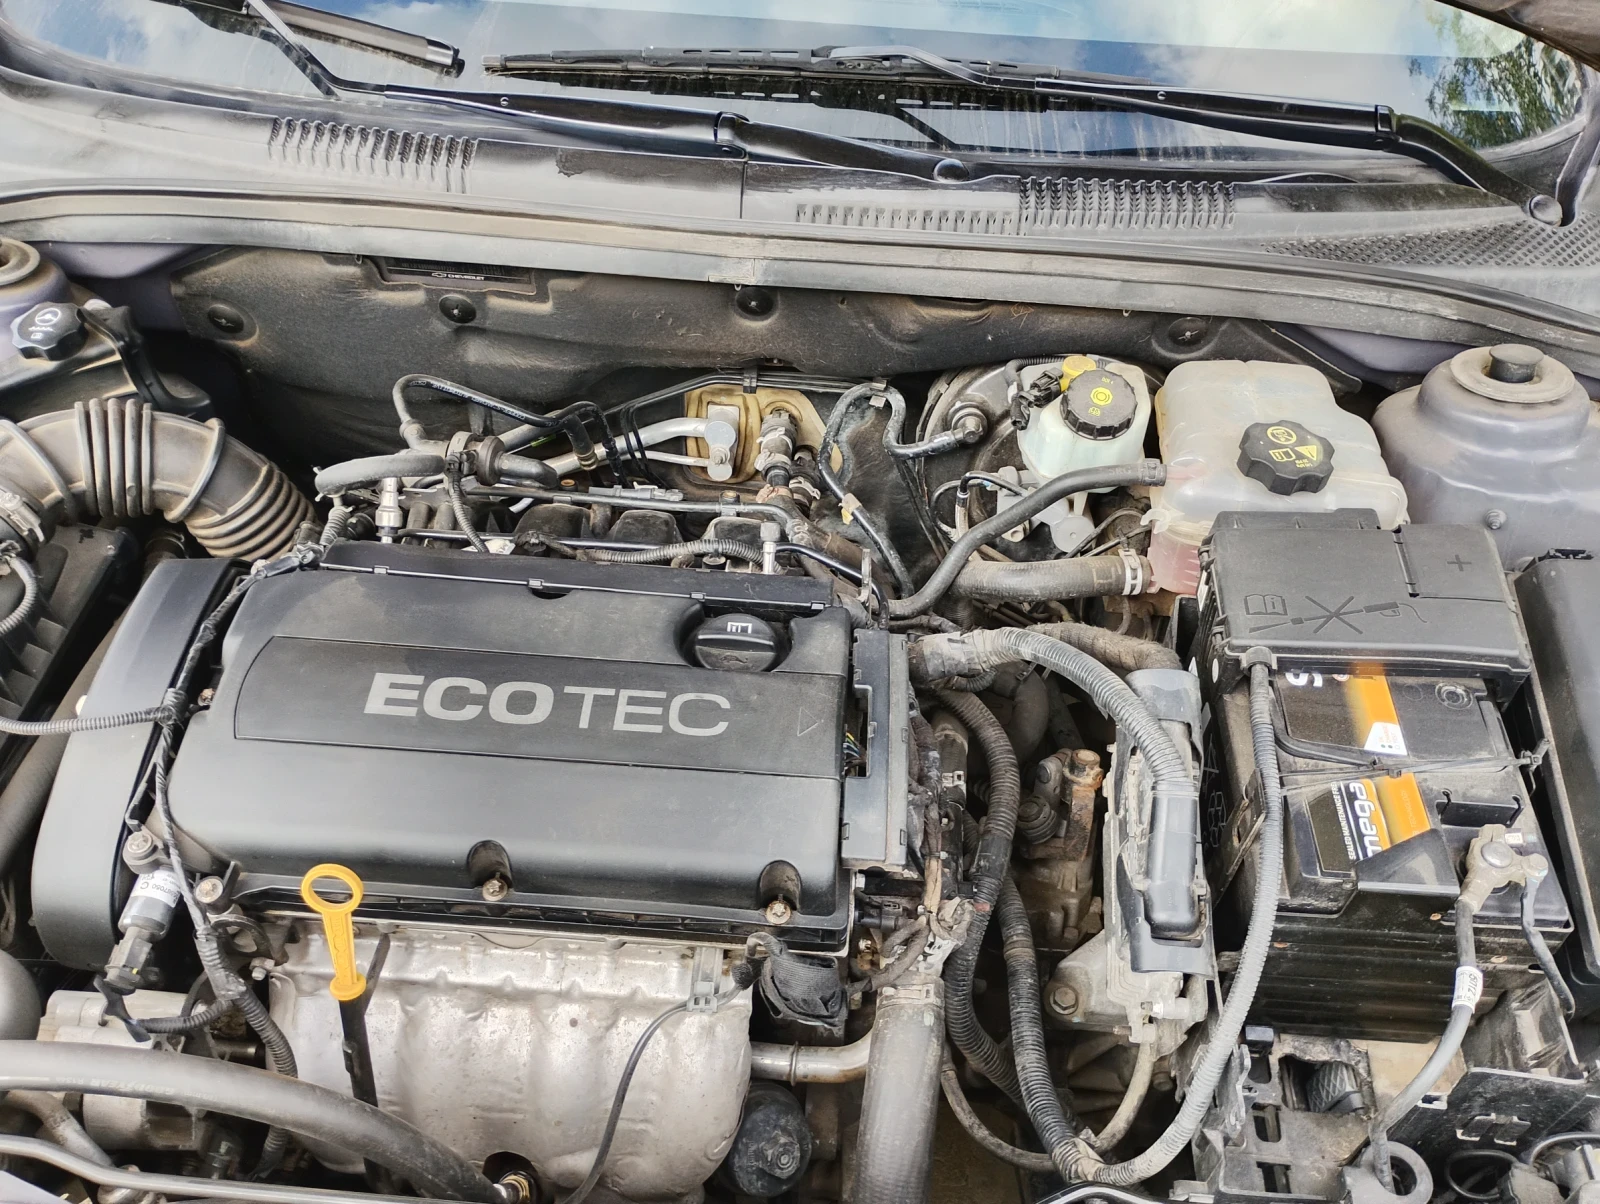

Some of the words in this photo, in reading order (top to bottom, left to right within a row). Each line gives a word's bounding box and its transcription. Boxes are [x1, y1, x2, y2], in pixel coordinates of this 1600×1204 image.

[447, 273, 485, 281] CHEVROLET
[363, 672, 731, 736] ECOTEC
[1333, 794, 1350, 836] MAINTENANCE
[1344, 836, 1356, 860] SEALED
